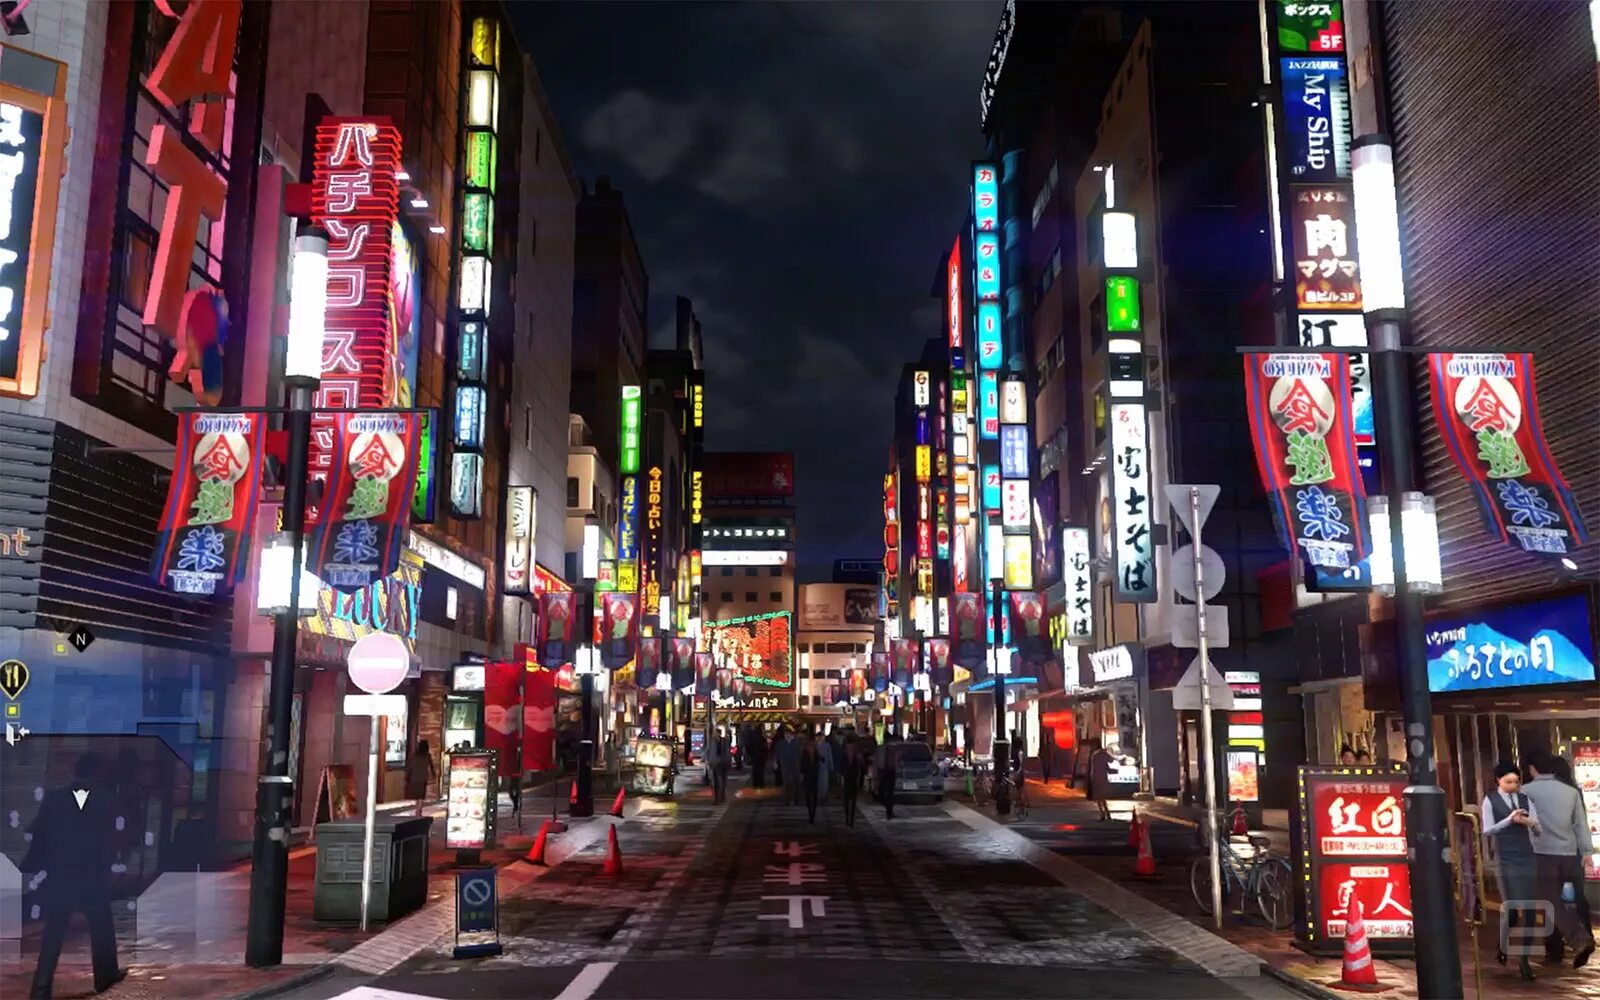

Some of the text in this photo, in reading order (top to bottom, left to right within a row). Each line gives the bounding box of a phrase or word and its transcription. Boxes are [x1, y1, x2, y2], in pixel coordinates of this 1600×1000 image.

[1285, 4, 1332, 16] ボックス
[1320, 35, 1343, 49] 5F
[1303, 73, 1326, 111] My
[1307, 116, 1331, 170] Ship
[1297, 258, 1358, 278] マグマ
[1117, 445, 1150, 592] 富士そば
[1070, 552, 1090, 636] 富士そば
[1328, 796, 1402, 835] 紅白
